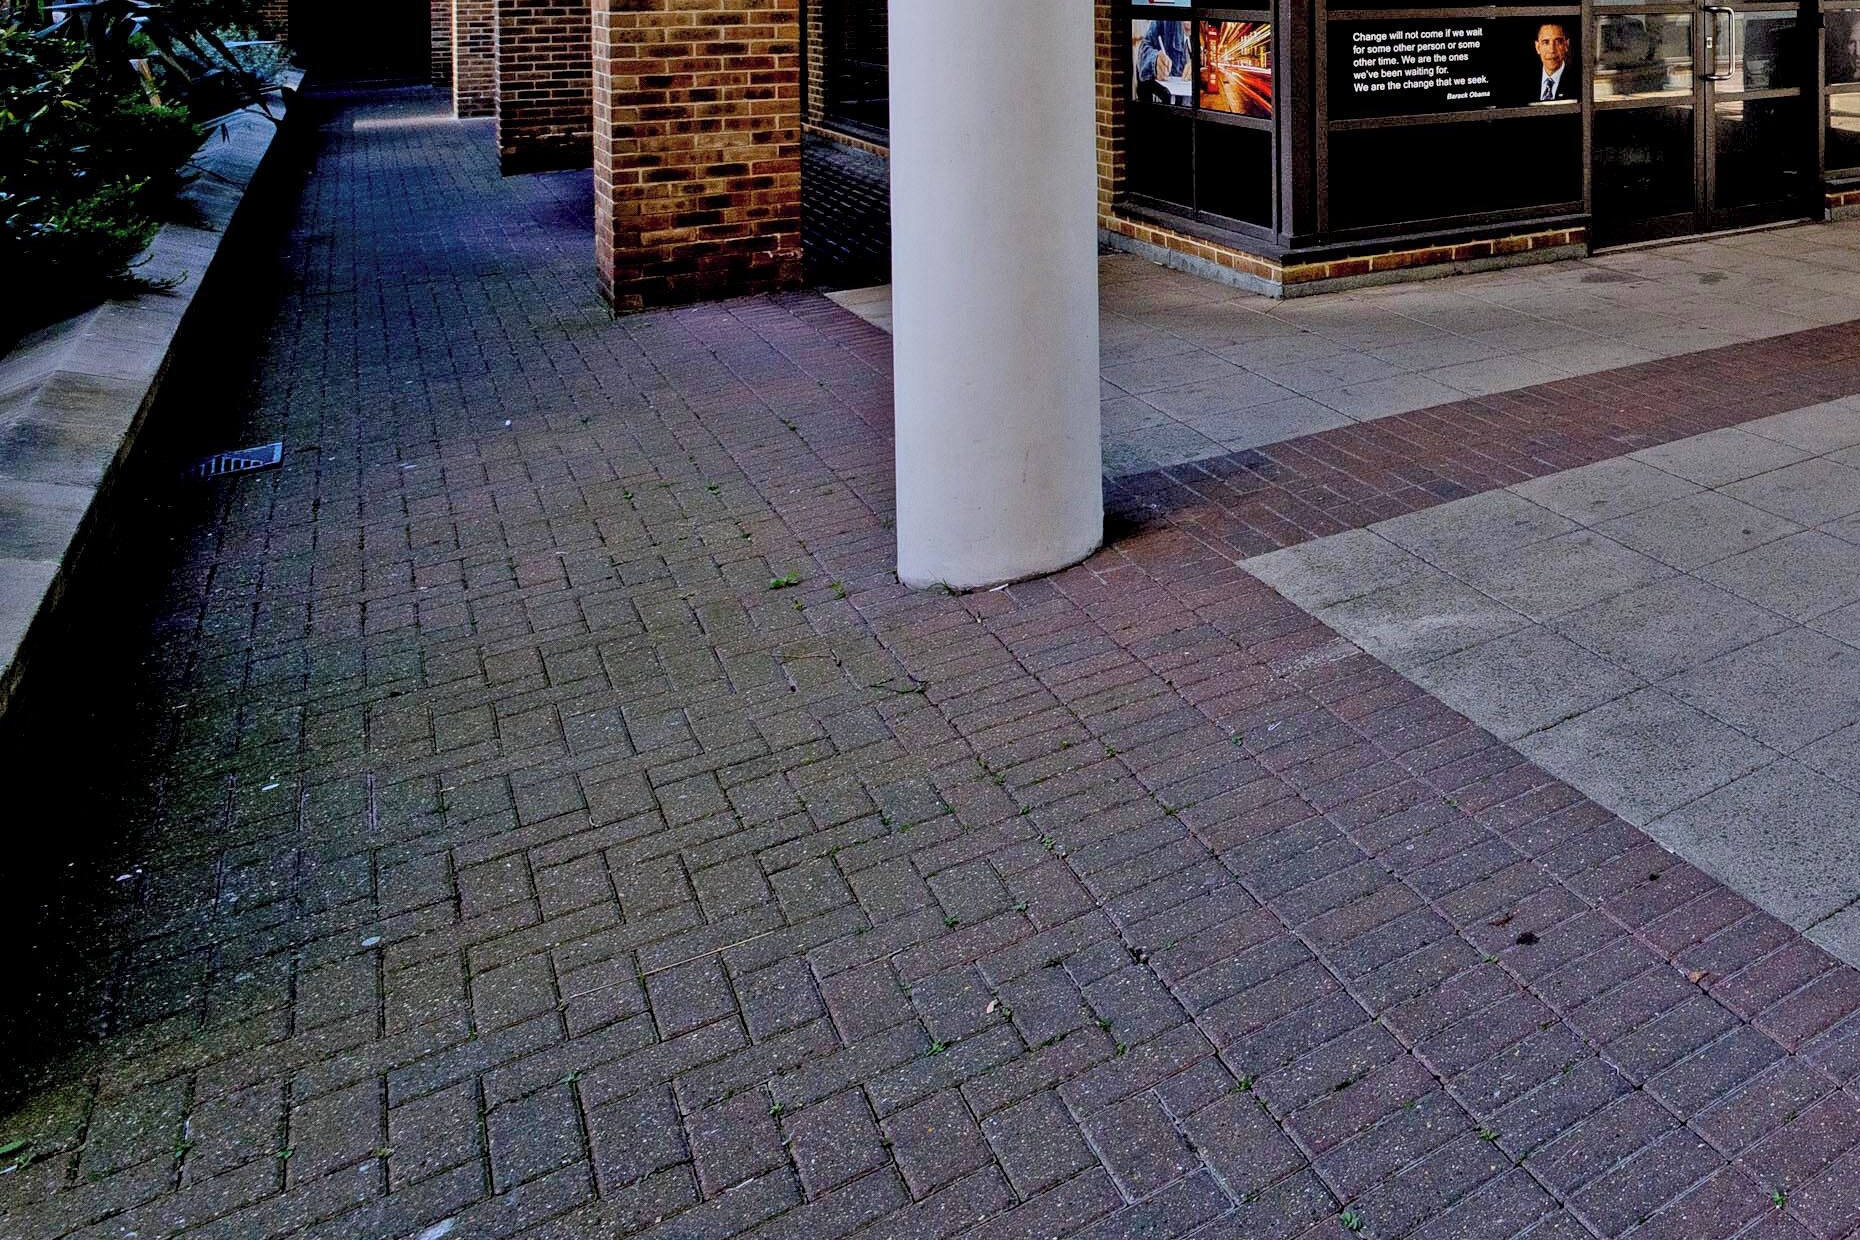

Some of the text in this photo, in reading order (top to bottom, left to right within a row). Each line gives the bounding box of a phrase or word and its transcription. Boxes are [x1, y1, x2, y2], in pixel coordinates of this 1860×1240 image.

[1353, 32, 1387, 42] Change
[1389, 31, 1403, 40] will
[1405, 31, 1419, 39] not
[1421, 30, 1443, 38] come
[1445, 28, 1451, 37] if
[1466, 28, 1483, 36] wait
[1353, 45, 1365, 54] for
[1367, 45, 1391, 53] some
[1393, 43, 1415, 52] other
[1417, 43, 1446, 53] person
[1353, 53, 1469, 67] other time. We are the ones
[1353, 65, 1449, 79] we've been waiting for.
[1354, 75, 1488, 92] We are the change that we seek.
